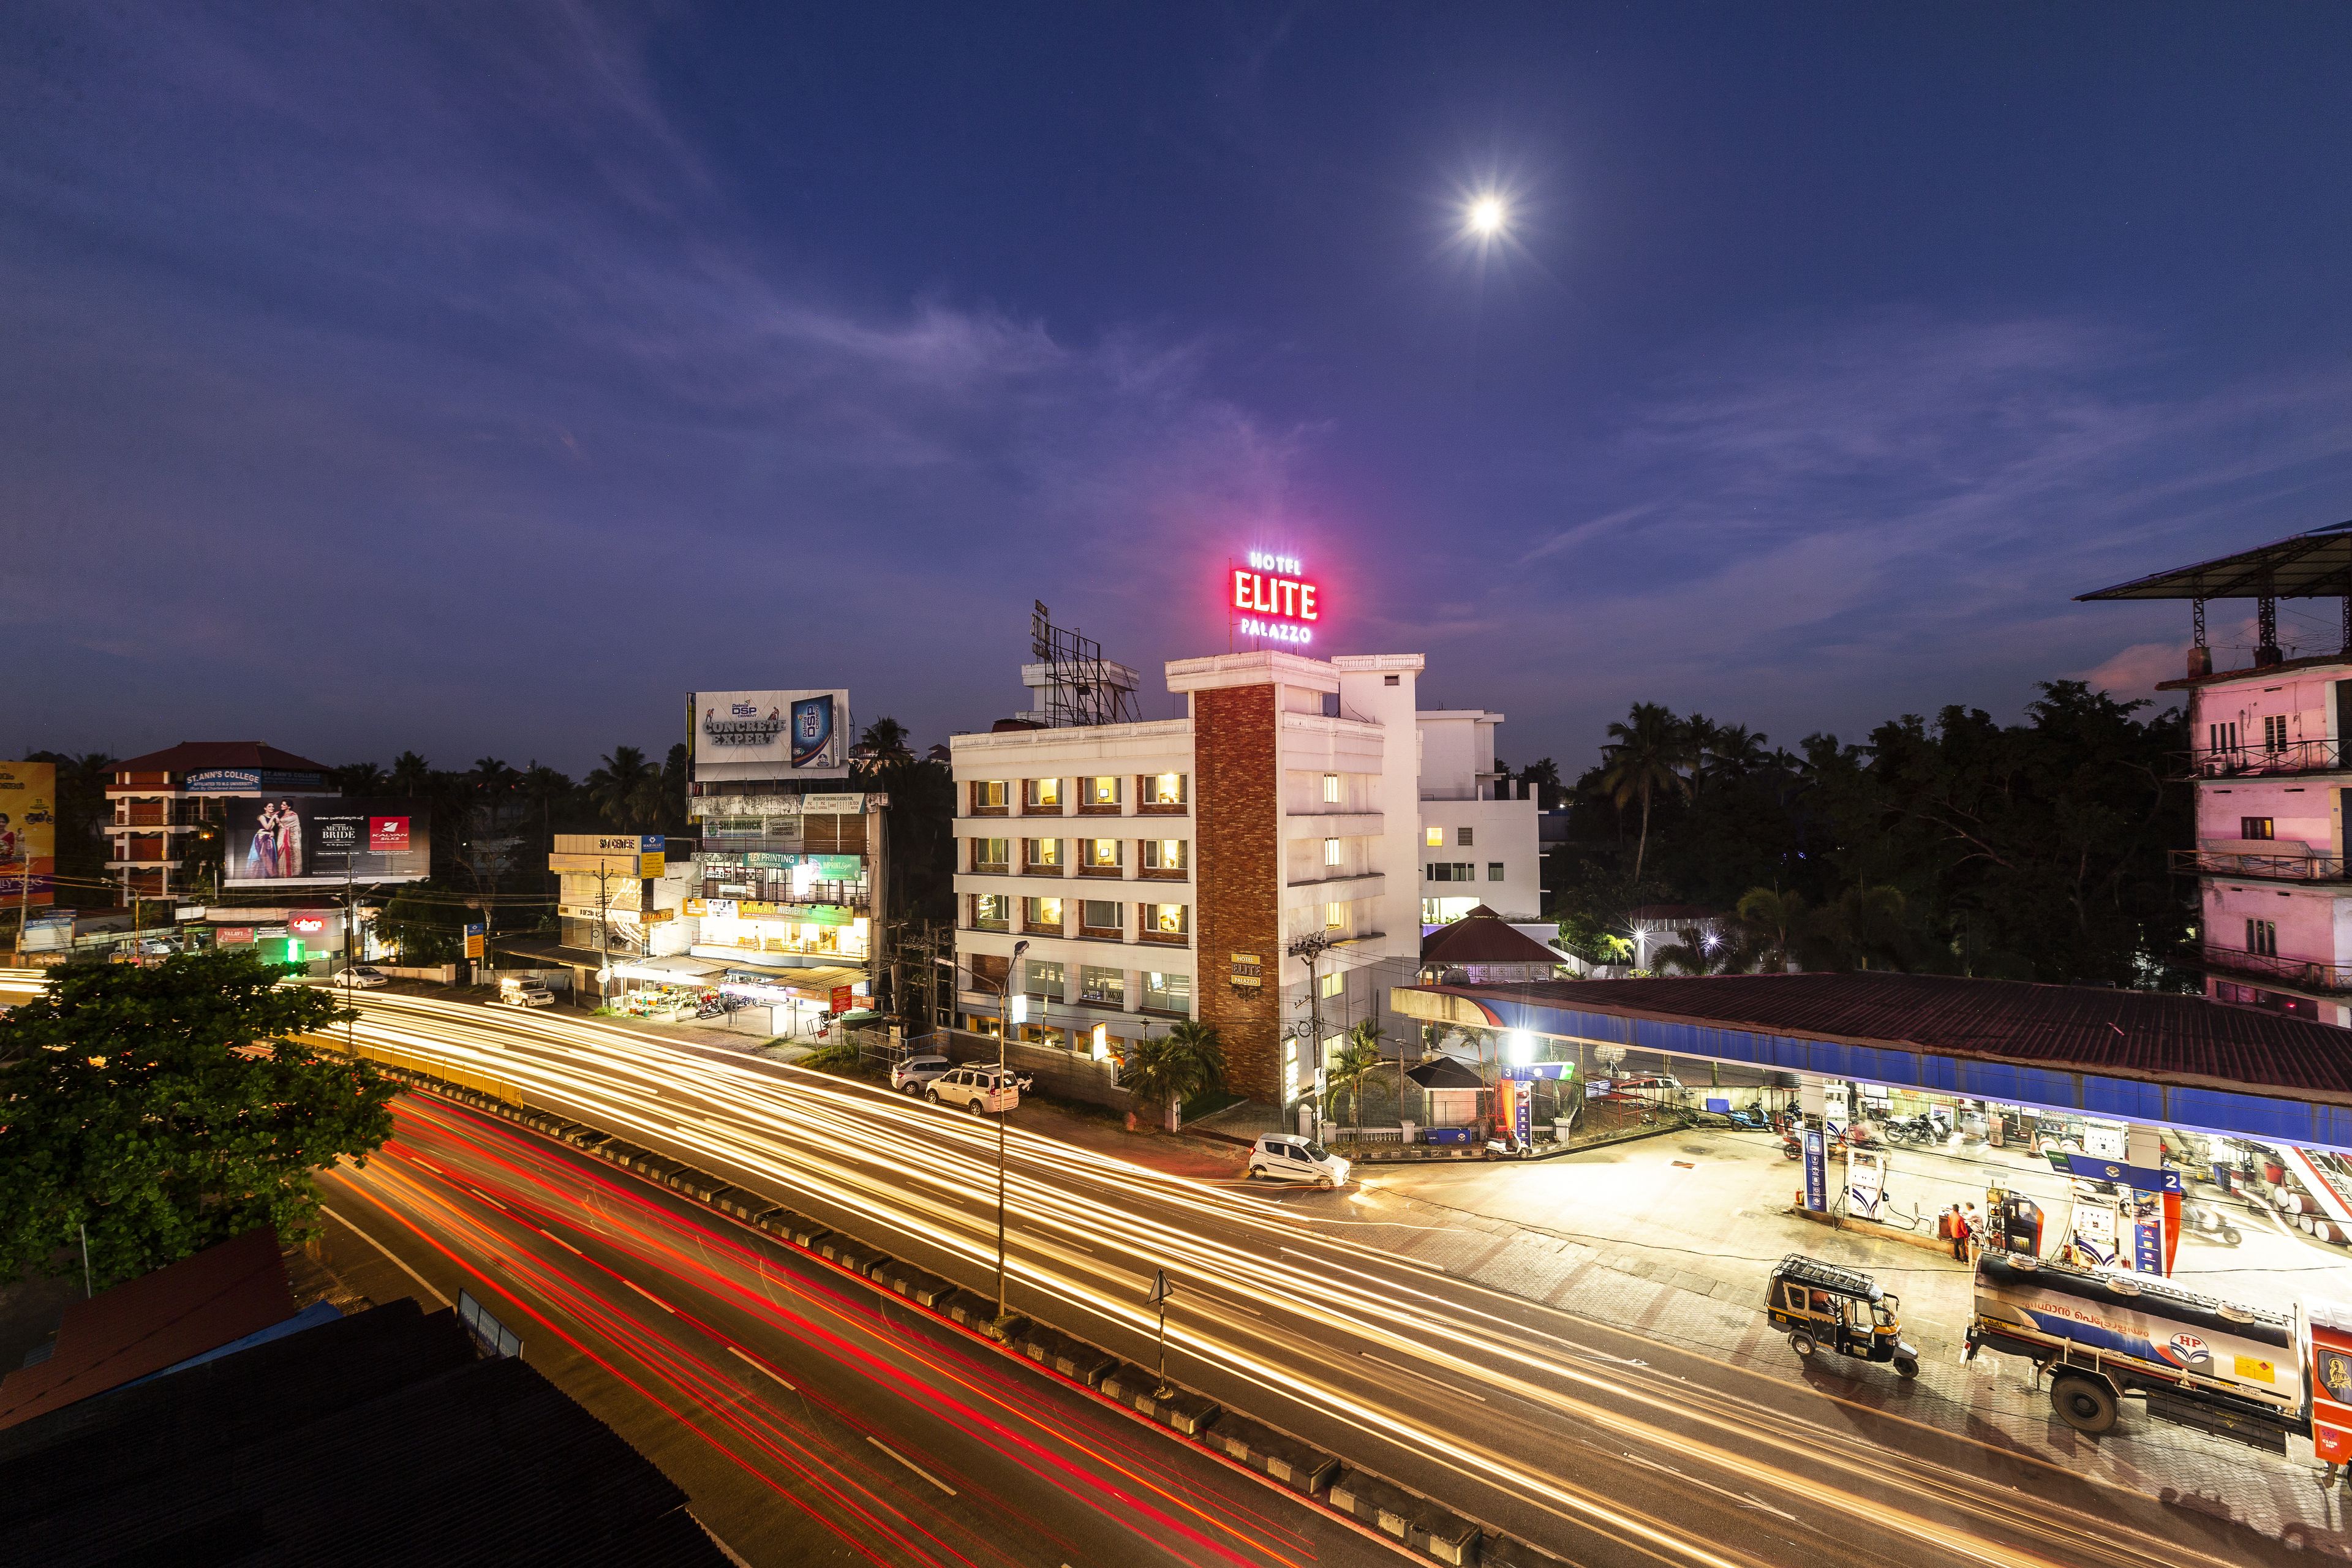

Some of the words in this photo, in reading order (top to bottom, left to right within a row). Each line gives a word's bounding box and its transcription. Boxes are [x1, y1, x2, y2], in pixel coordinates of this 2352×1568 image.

[1251, 552, 1301, 575] HOTEL
[1235, 571, 1317, 620] ELITE
[1242, 618, 1311, 643] PALAZZO
[703, 720, 786, 733] CONCRETE
[807, 705, 816, 737] DSP
[711, 733, 775, 746] EXPERT
[224, 771, 260, 783] COLLEGE
[718, 820, 762, 830] SHAMROCK
[761, 854, 794, 864] PRINTING
[742, 904, 776, 913] MANGALY
[778, 906, 801, 914] INVERTER
[642, 913, 673, 921] LUKER
[1232, 963, 1261, 976] ELITE
[1505, 1068, 1512, 1077] 3
[2165, 1175, 2177, 1188] 2
[2179, 1336, 2201, 1348] HP
